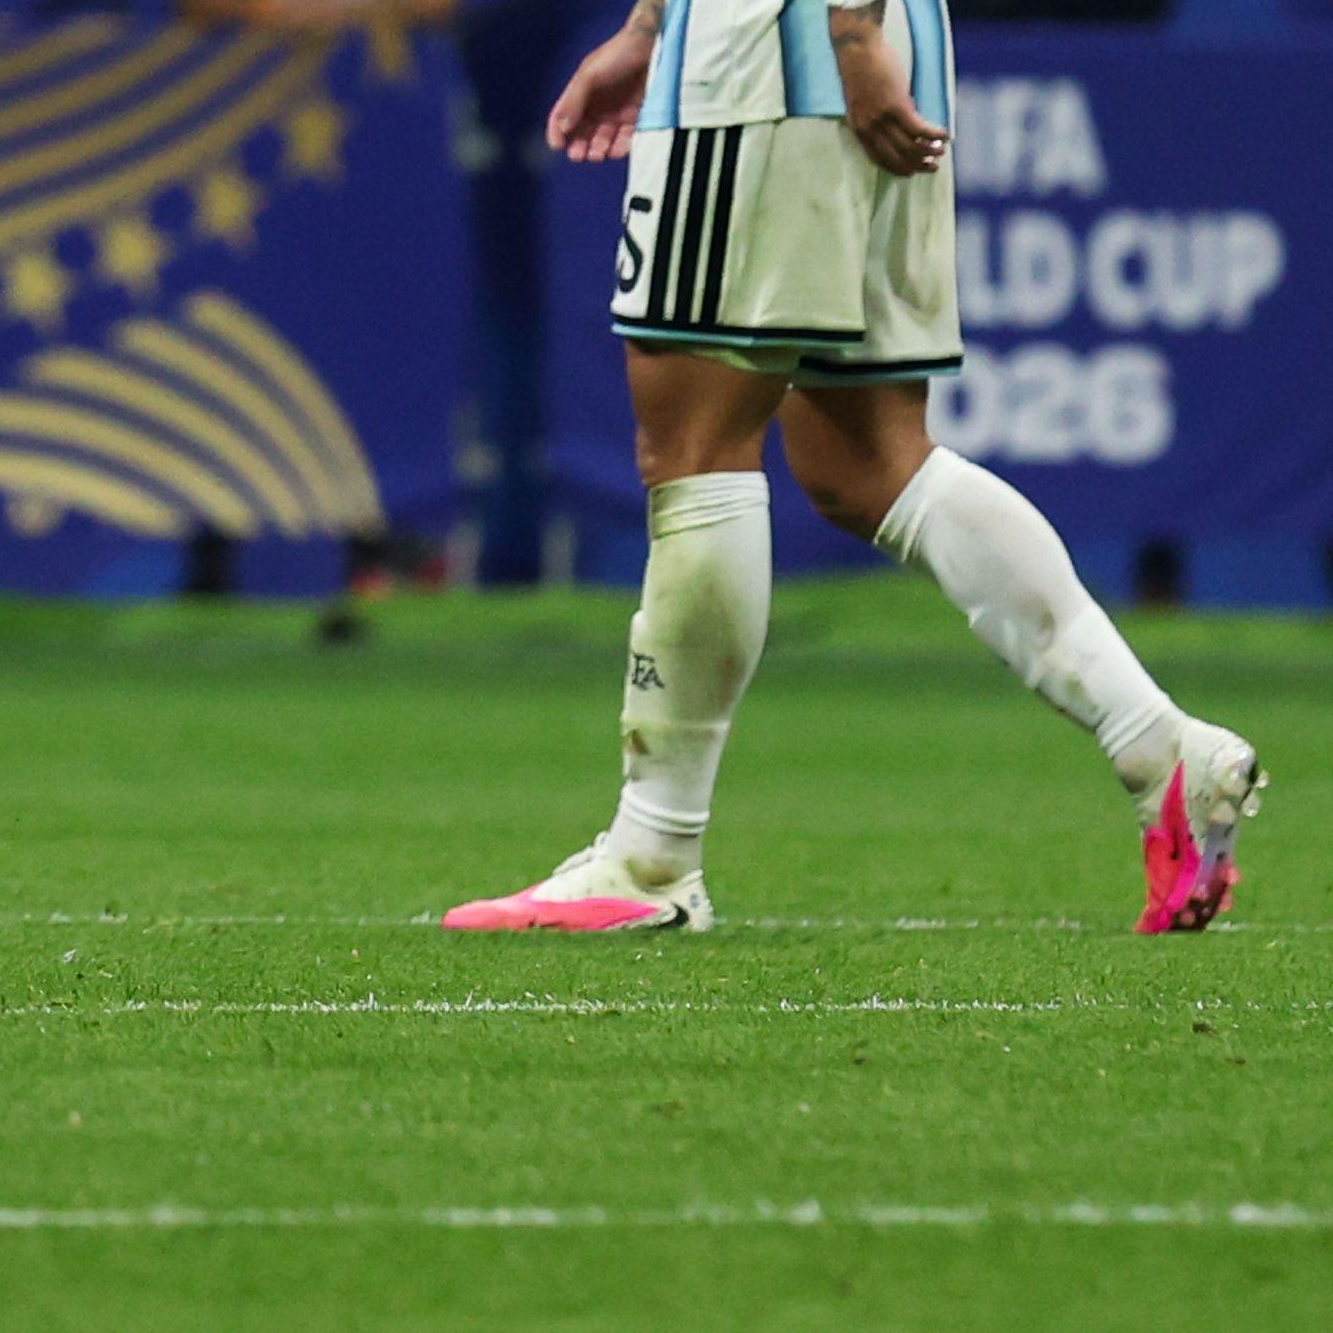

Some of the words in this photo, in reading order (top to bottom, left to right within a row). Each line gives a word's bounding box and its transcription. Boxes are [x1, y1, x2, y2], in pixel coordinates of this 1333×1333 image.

[955, 77, 1108, 195] IFA
[1087, 210, 1287, 330] CUP
[926, 343, 1175, 463] 026
